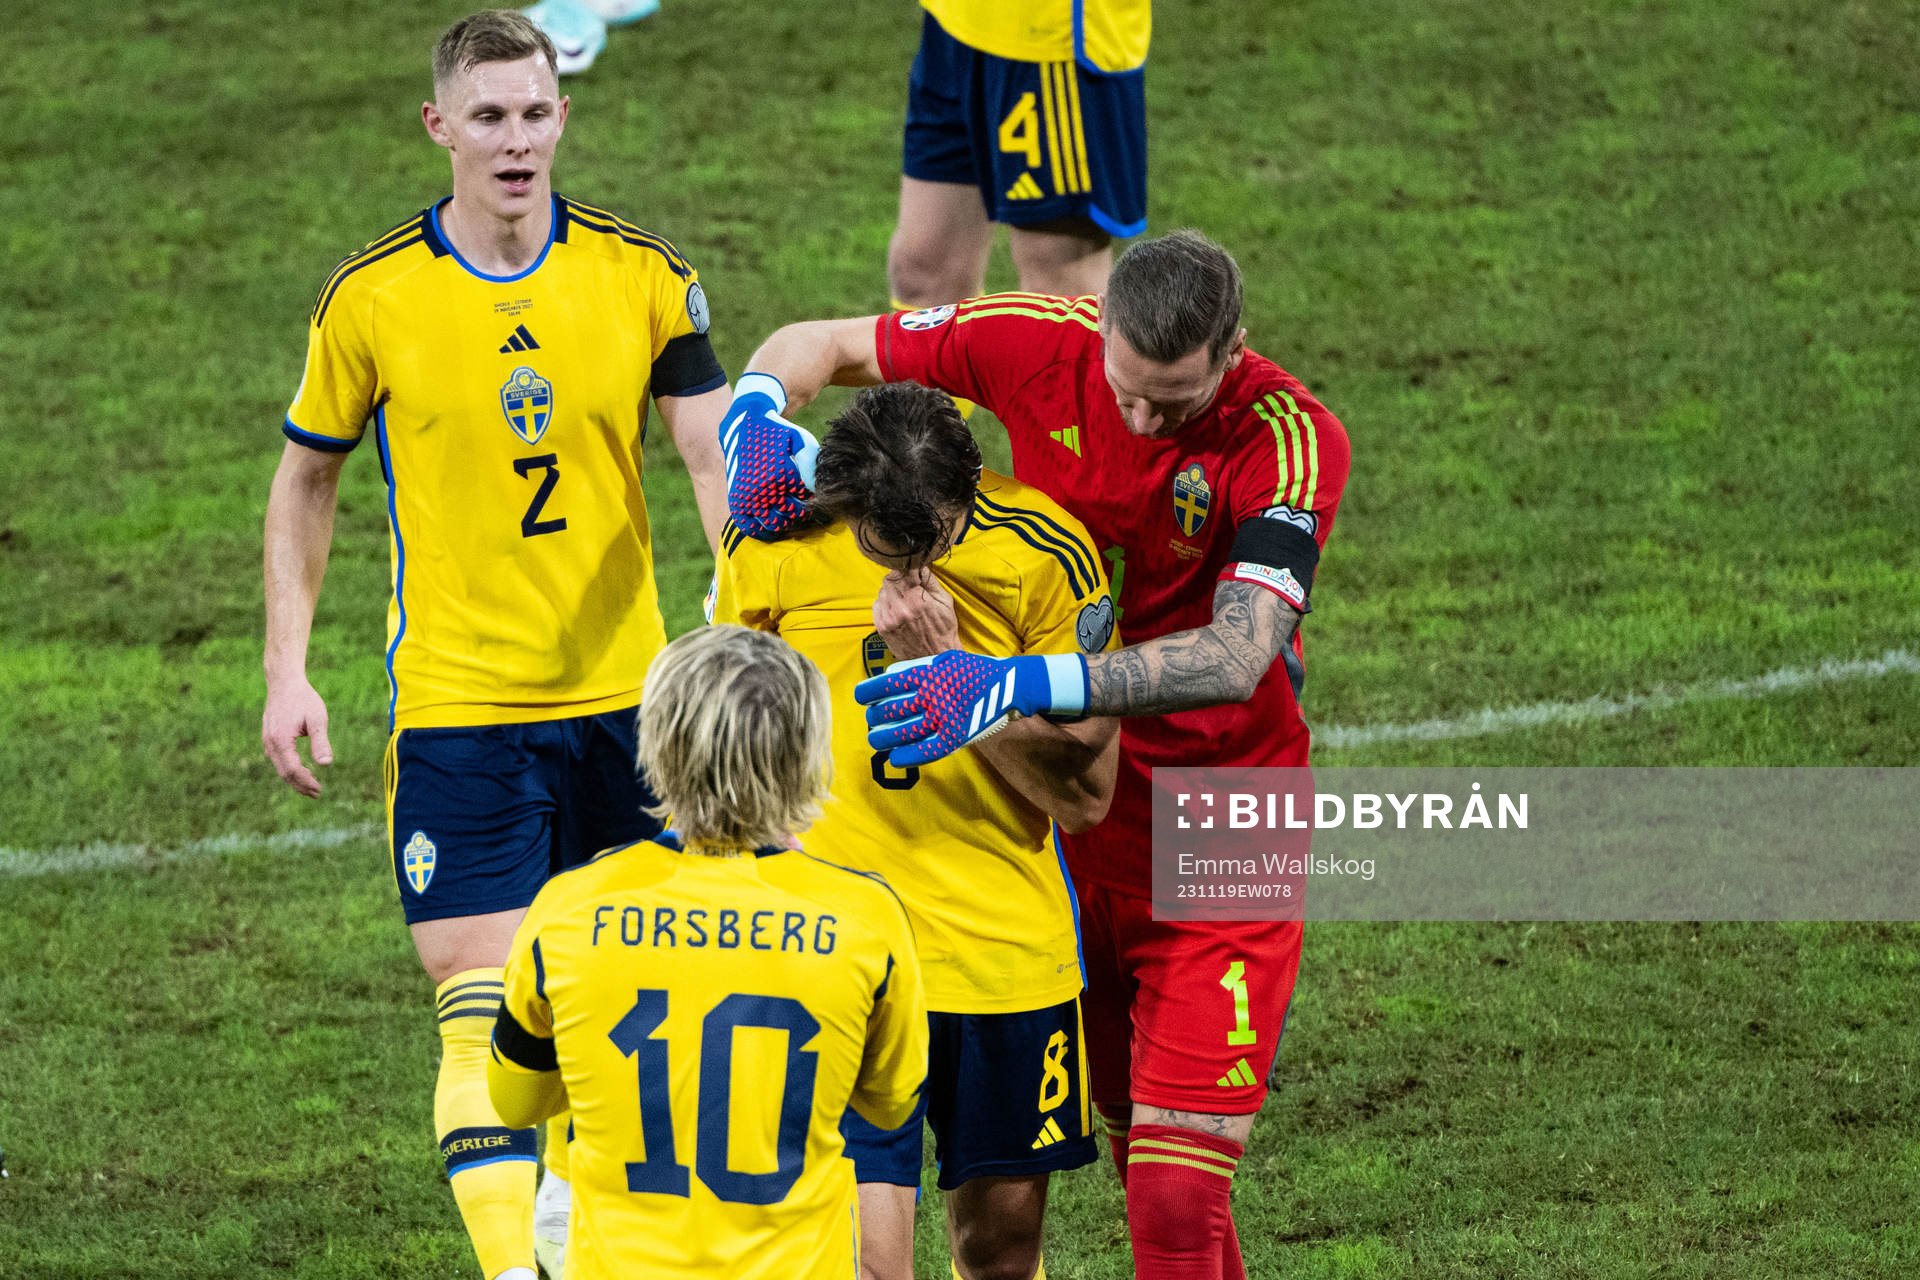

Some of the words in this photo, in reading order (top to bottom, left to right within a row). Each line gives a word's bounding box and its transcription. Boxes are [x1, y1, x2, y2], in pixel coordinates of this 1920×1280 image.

[998, 92, 1042, 169] 4
[510, 388, 543, 399] SVERIGE
[513, 453, 568, 538] 2
[592, 906, 838, 955] FORSBERG
[1219, 961, 1257, 1046] 1
[607, 988, 821, 1205] 10
[1038, 1030, 1070, 1113] 8
[442, 1135, 512, 1162] SVERIGE
